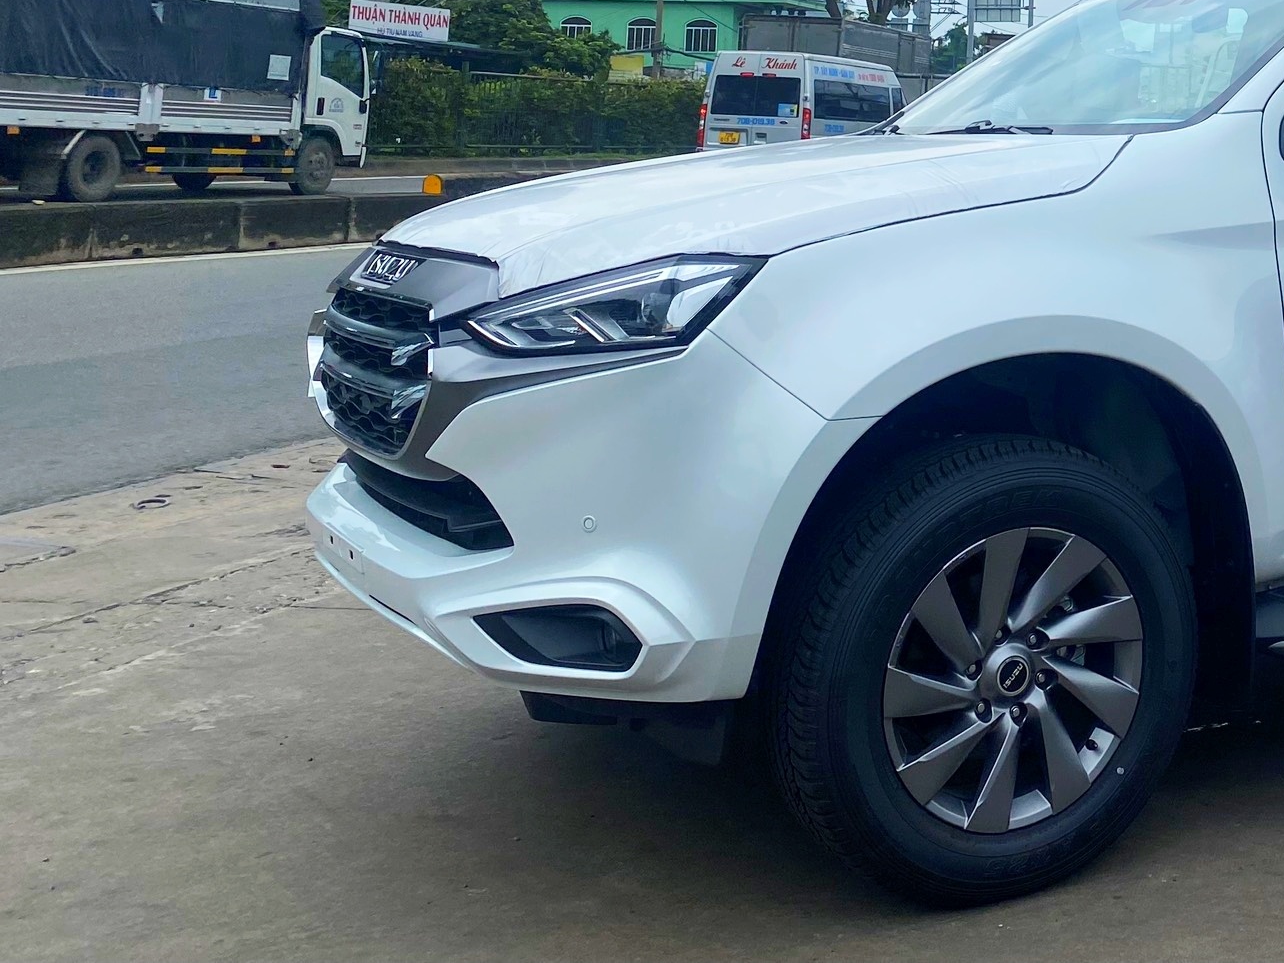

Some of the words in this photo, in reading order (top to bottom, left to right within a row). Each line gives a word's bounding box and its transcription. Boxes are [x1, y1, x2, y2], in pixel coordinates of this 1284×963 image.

[352, 3, 386, 24] THUẬN
[388, 7, 420, 26] THÀNH
[423, 11, 449, 30] QUÁN
[761, 57, 797, 70] Khánh
[366, 253, 416, 280] ISUZU
[1003, 663, 1024, 688] ISUZU
